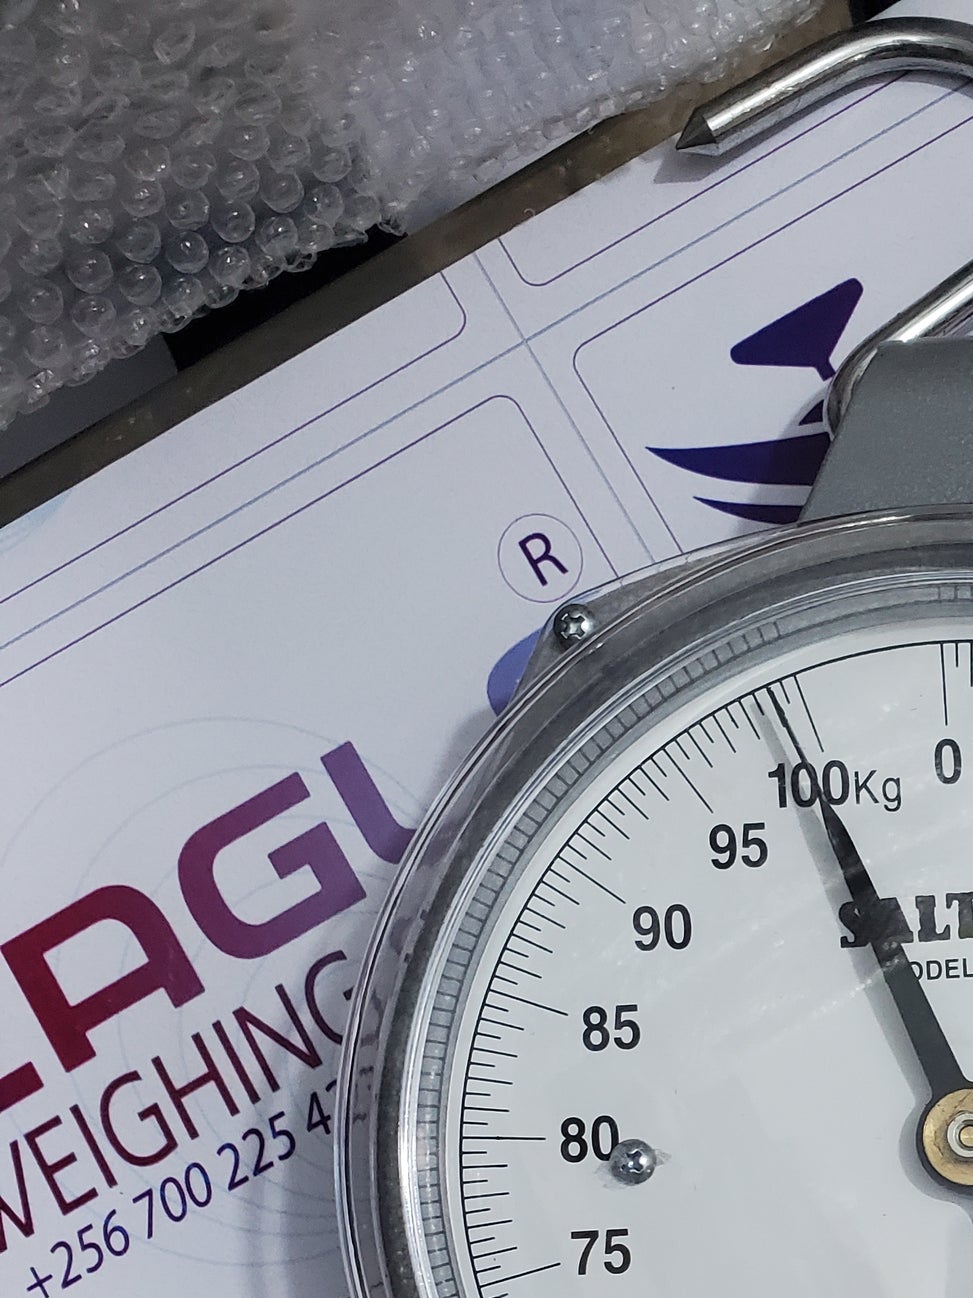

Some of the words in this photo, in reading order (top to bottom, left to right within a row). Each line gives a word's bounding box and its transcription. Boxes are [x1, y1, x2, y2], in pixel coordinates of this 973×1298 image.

[934, 738, 962, 785] 0
[708, 822, 768, 870] 95
[632, 904, 692, 951] 90
[582, 1004, 641, 1051] 85
[560, 1115, 620, 1163] 80
[132, 1162, 213, 1239] 700
[216, 1111, 297, 1190] 225
[570, 1228, 631, 1275] 75
